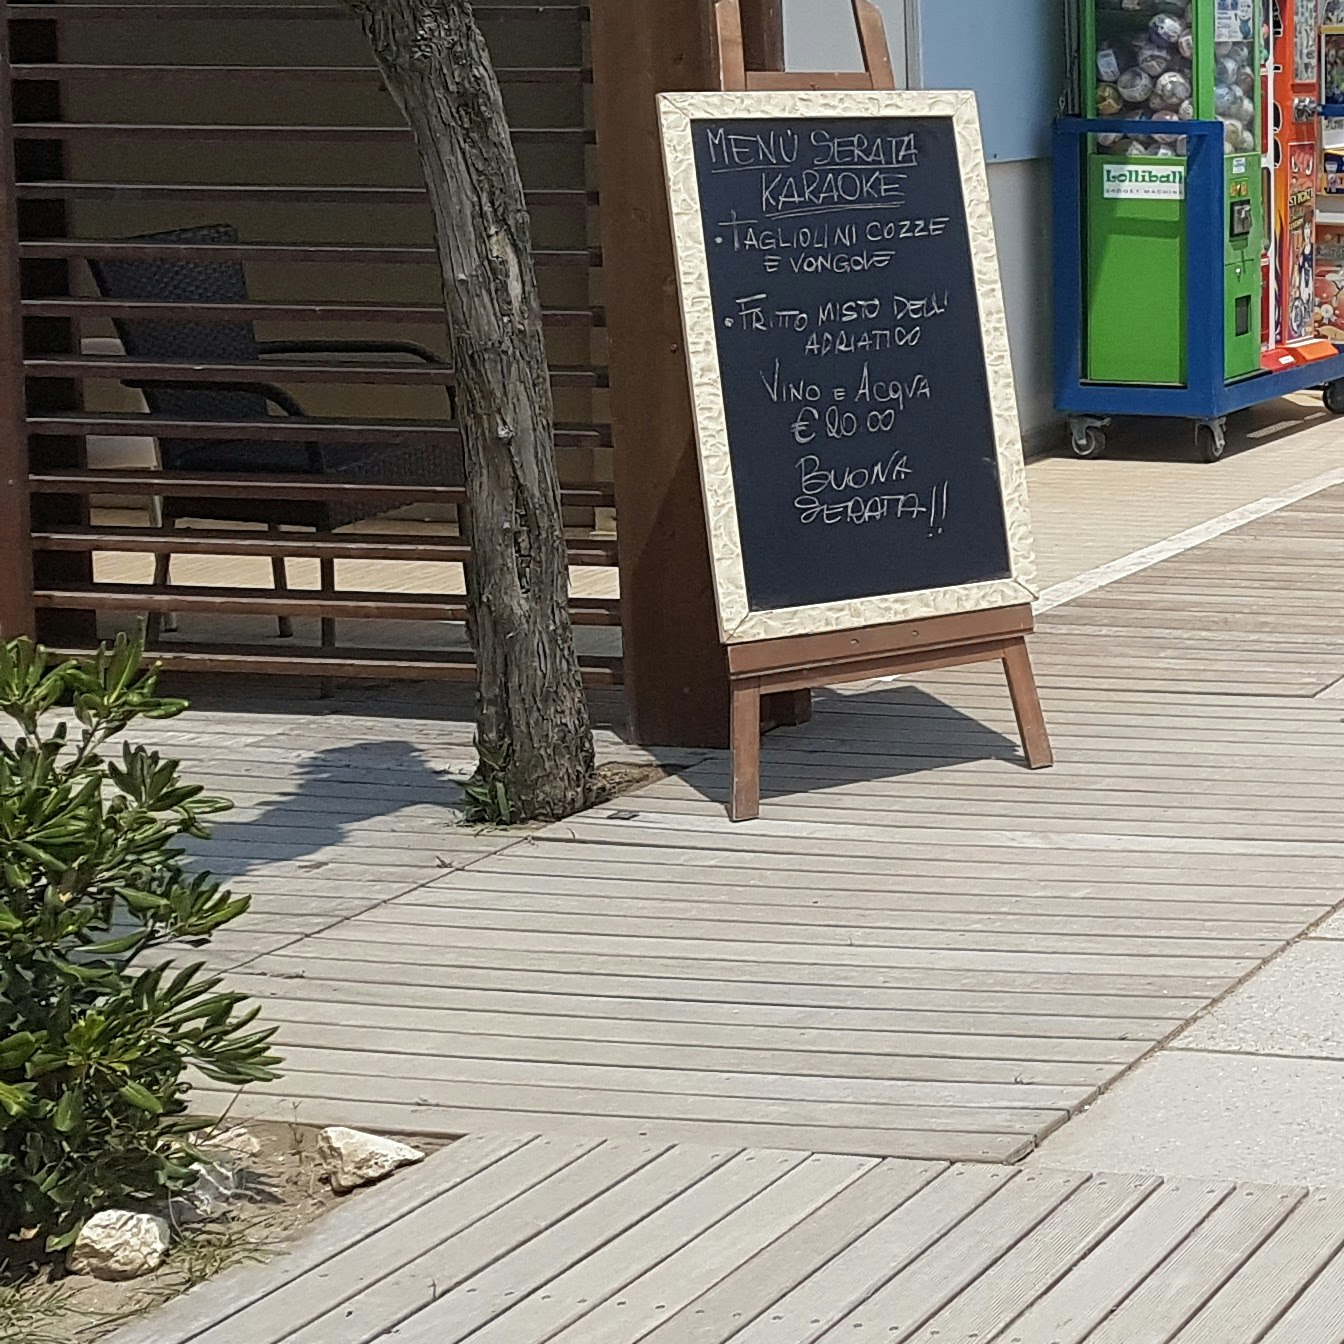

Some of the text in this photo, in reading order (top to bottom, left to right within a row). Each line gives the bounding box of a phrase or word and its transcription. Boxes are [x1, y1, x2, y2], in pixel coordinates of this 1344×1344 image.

[810, 130, 918, 166] SERATA
[761, 169, 908, 212] KARAOKE
[1105, 169, 1183, 184] Lolliball
[866, 217, 950, 242] COZZE
[764, 250, 896, 274] E VONGOLE
[735, 293, 808, 332] FRITTO
[818, 298, 881, 326] MISTO
[804, 326, 921, 356] ADRIATICO
[795, 450, 913, 495] BUONA
